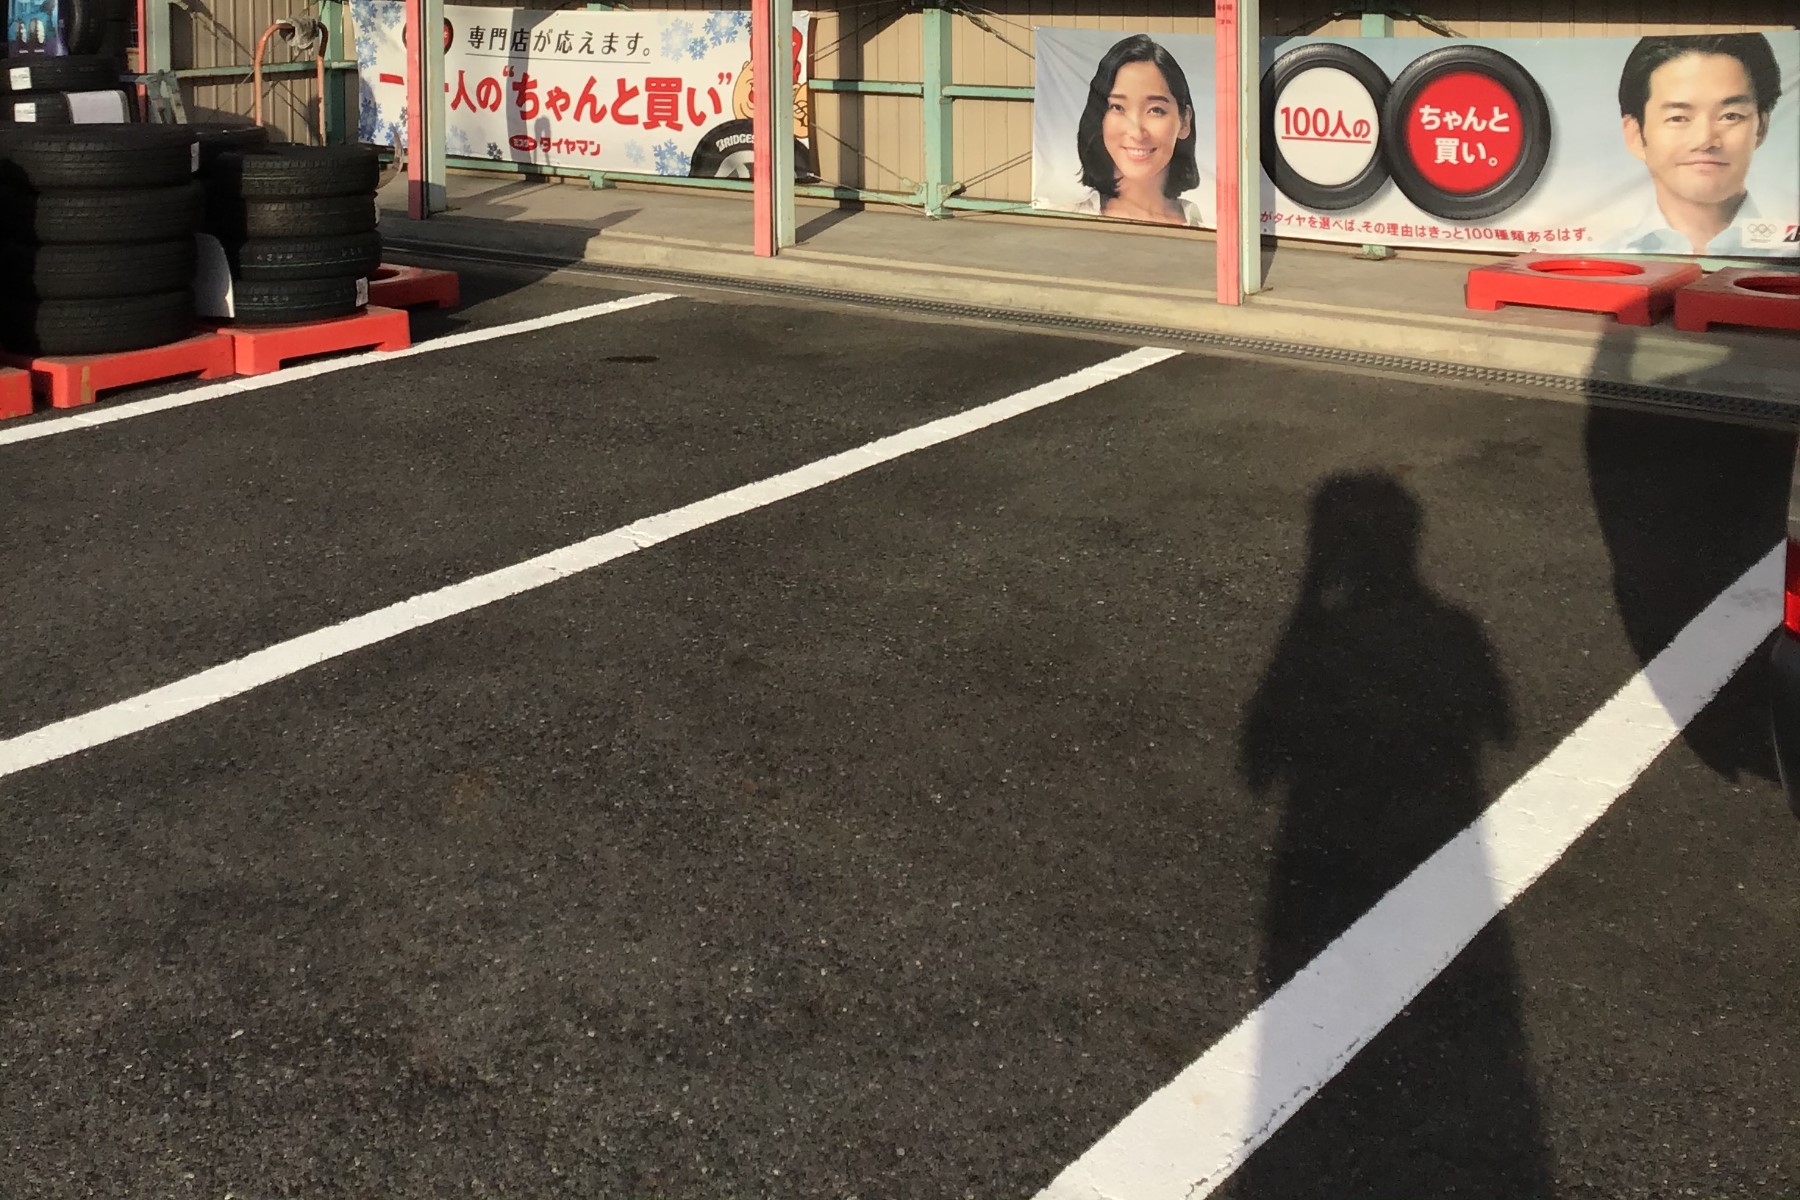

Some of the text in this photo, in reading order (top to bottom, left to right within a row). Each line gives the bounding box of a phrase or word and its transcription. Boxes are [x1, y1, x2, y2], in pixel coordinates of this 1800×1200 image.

[467, 25, 650, 57] 専門店が応えます。
[1281, 107, 1371, 139] 100人の
[1419, 104, 1510, 133] ちゃんと
[540, 137, 601, 156] タイヤマン
[1434, 138, 1498, 167] 買い。
